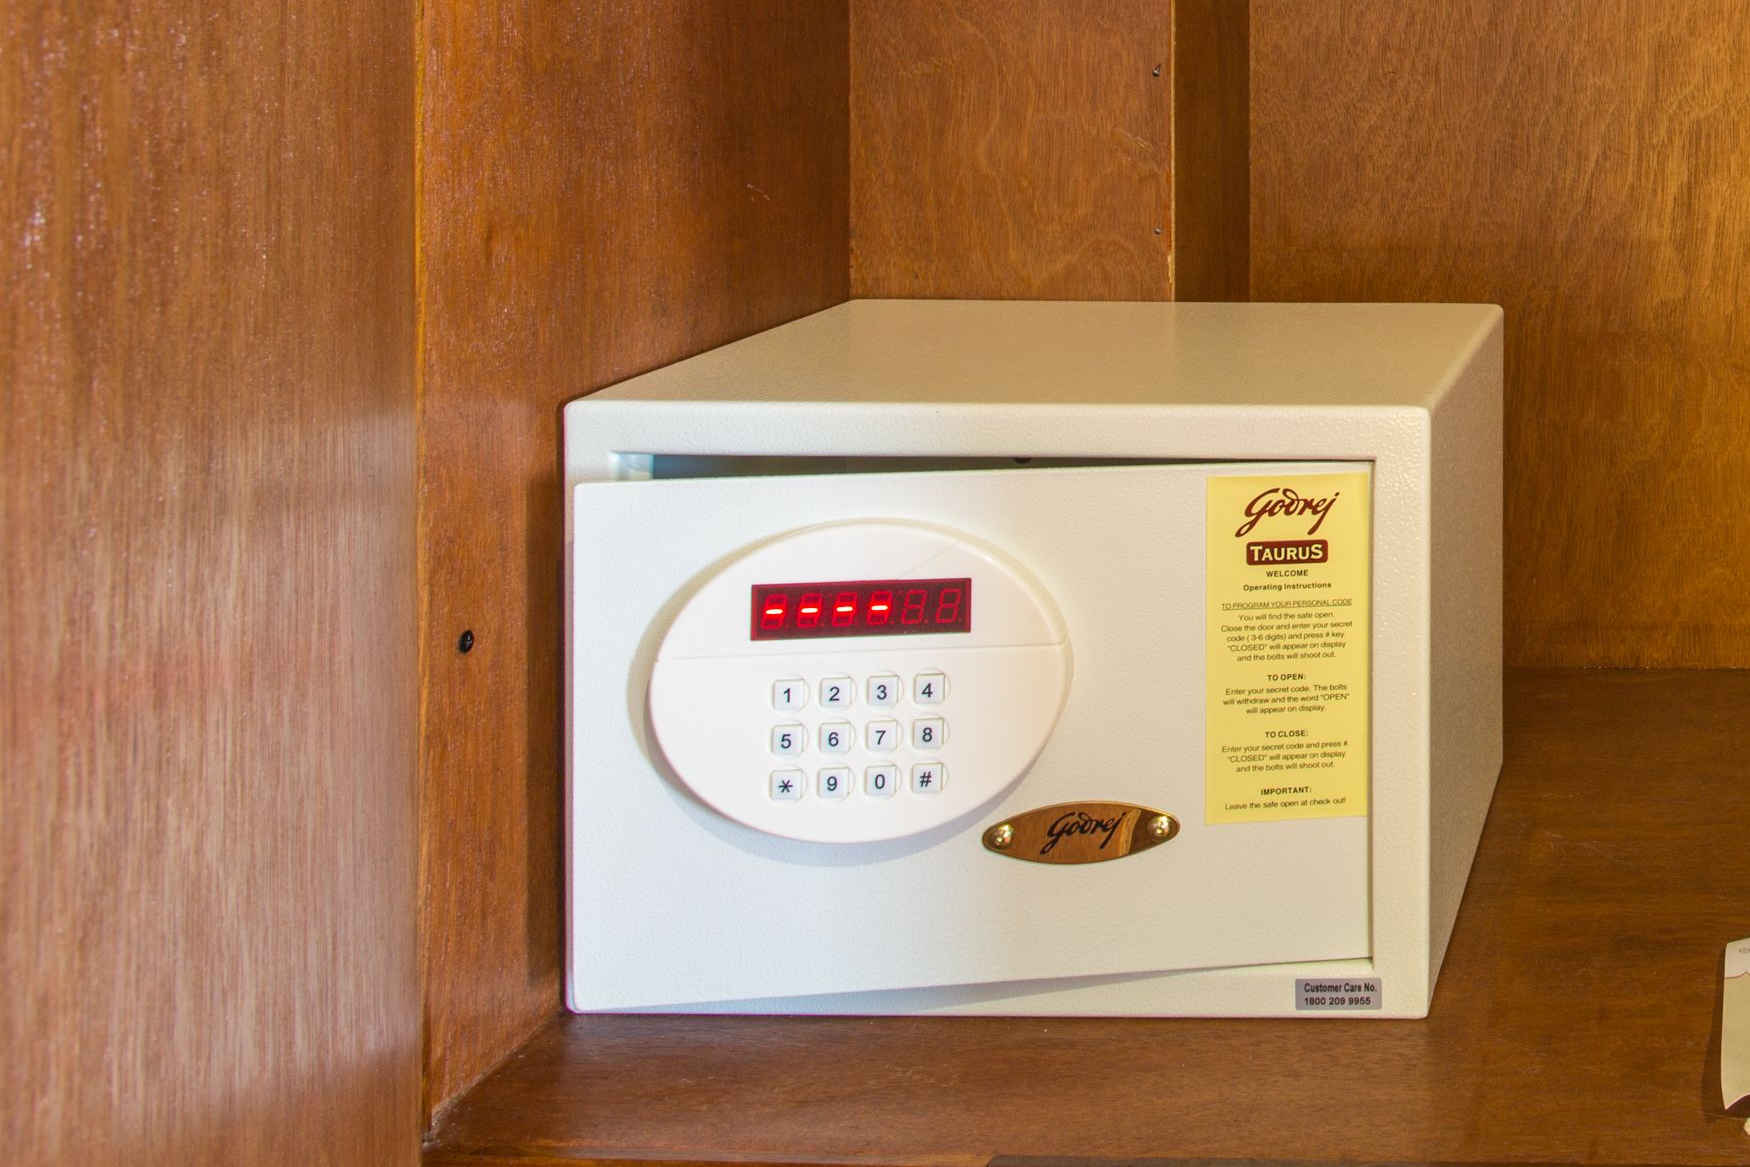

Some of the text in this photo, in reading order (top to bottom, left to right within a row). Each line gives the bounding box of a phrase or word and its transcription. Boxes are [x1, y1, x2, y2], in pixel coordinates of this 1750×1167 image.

[1234, 487, 1340, 537] Godrej
[1250, 544, 1324, 562] TAURUS
[1265, 569, 1309, 578] WELCOME
[1243, 582, 1332, 593] Operating Instructions
[1233, 601, 1270, 609] PROGRAM
[1272, 600, 1292, 608] YOUR
[1293, 599, 1331, 607] PERSONAL
[1257, 623, 1273, 631] door
[1275, 622, 1290, 630] and
[1312, 622, 1328, 630] your
[1226, 634, 1245, 642] code
[1303, 632, 1323, 641] press
[1269, 643, 1280, 651] will
[1282, 642, 1308, 651] appear
[1320, 641, 1346, 650] display
[1237, 654, 1251, 662] and
[1266, 653, 1285, 661] bolts
[1280, 673, 1307, 681] OPEN:
[783, 682, 933, 703] 1 2 3 4
[1247, 688, 1264, 696] your
[1265, 686, 1289, 694] secret
[1290, 685, 1311, 693] code.
[1329, 683, 1348, 691] bolts
[1223, 693, 1350, 706] will withdraw and the word "OPEN"
[1259, 706, 1286, 715] appear
[780, 727, 933, 749] 5 6 7 8
[1278, 729, 1309, 738] CLOSE:
[1221, 745, 1242, 753] Enter
[1243, 745, 1260, 754] your
[1286, 742, 1304, 750] code
[1305, 741, 1320, 749] and
[1321, 741, 1341, 749] press
[1269, 753, 1280, 761] will
[1281, 753, 1308, 761] appear
[1320, 751, 1346, 760] display
[1236, 765, 1250, 773] and
[1252, 764, 1264, 772] the
[1265, 763, 1284, 771] bolts
[1299, 761, 1320, 769] shoot
[827, 776, 838, 792] 9
[874, 773, 885, 789] 0
[919, 771, 932, 788] #
[1260, 786, 1312, 796] IMPORTANT:
[1262, 801, 1279, 809] safe
[1280, 800, 1299, 808] open
[1300, 799, 1308, 807] at
[1309, 798, 1331, 806] check
[1040, 811, 1127, 855] Godrej
[1304, 982, 1378, 993] Customer Care No.
[1304, 996, 1371, 1006] 1800 209 9955
